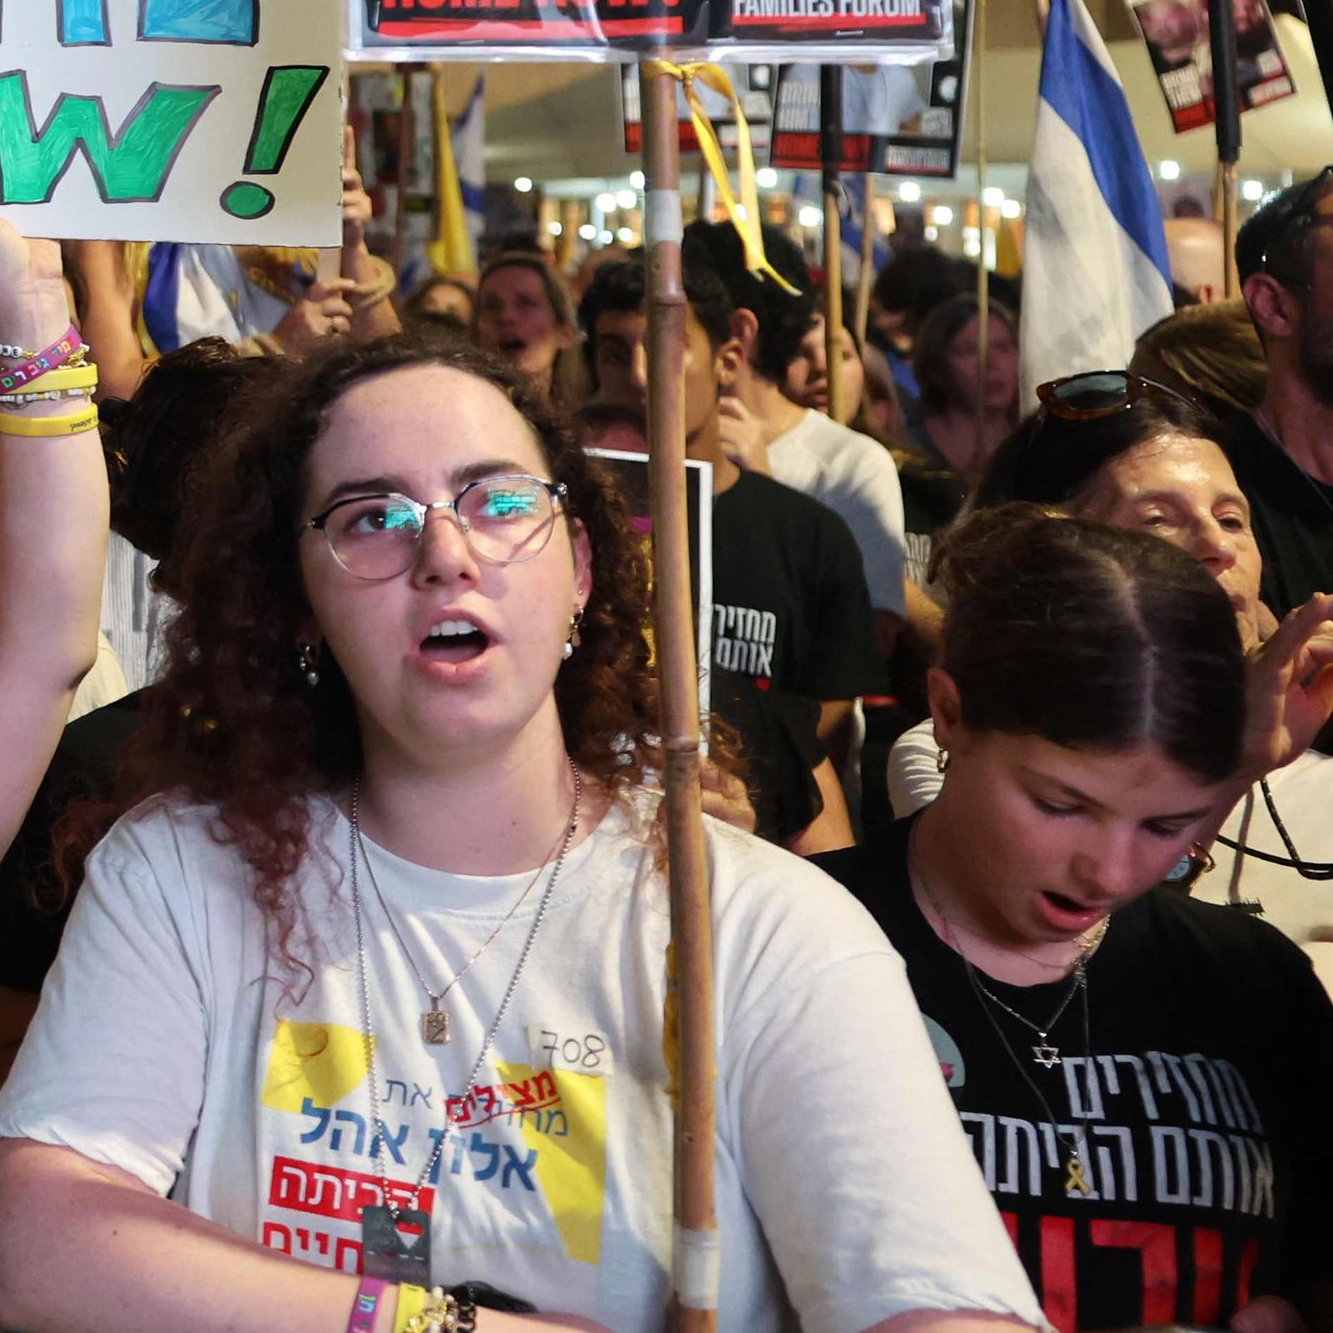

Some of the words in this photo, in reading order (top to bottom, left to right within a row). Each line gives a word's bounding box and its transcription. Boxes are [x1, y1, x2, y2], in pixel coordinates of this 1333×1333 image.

[782, 82, 821, 104] BRIN
[541, 1028, 606, 1068] 708
[383, 1078, 433, 1108] את
[300, 1097, 409, 1165] אהל
[1150, 1124, 1274, 1219] אותם
